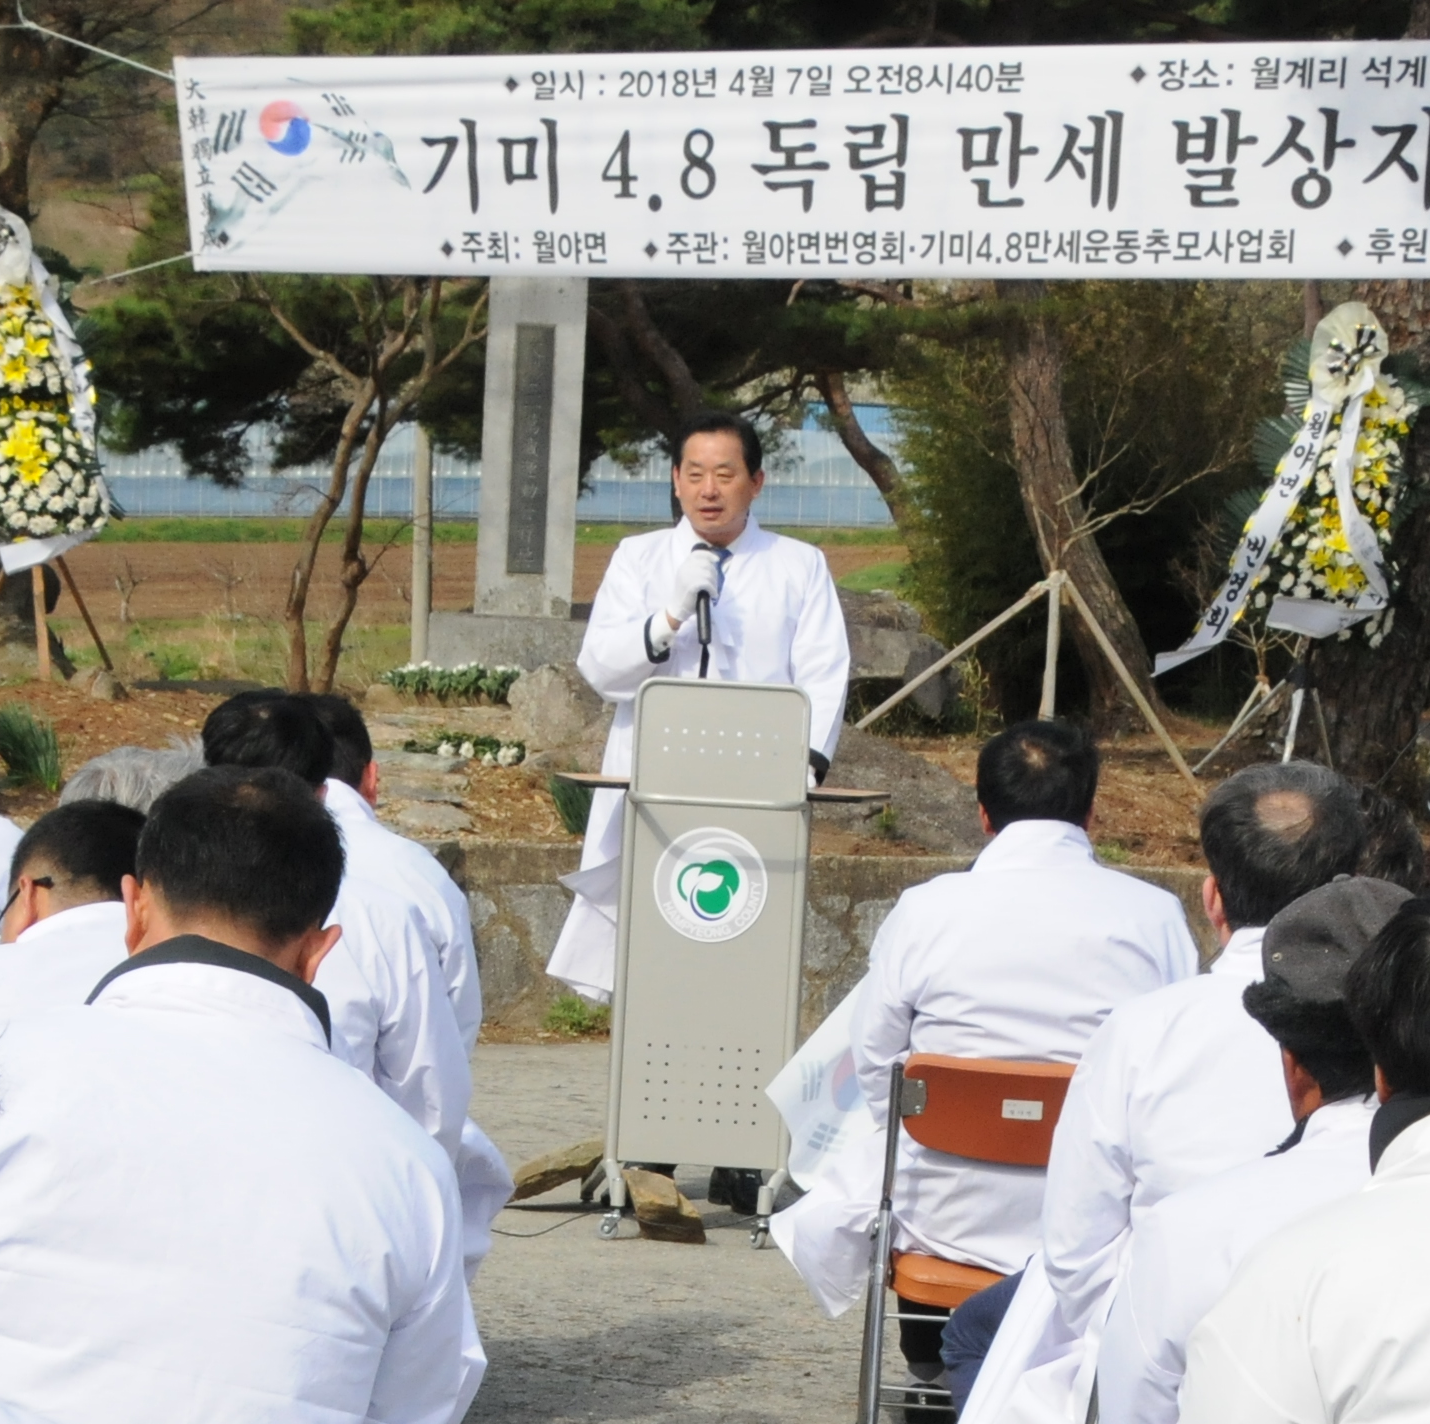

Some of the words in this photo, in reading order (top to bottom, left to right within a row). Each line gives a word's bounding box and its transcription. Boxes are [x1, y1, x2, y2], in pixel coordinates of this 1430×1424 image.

[530, 71, 585, 100] 일시
[618, 69, 717, 98] 2018년
[728, 67, 775, 98] 4월
[787, 67, 833, 97] 7일
[844, 63, 1024, 96] 오전8시40분
[1250, 57, 1349, 90] 월계리
[1361, 55, 1428, 90] 석계
[421, 117, 560, 214] 기미
[601, 129, 718, 212] 4.8
[750, 114, 910, 212] 독립
[956, 110, 1125, 211] 만세
[531, 230, 607, 264] 월야면
[733, 881, 762, 928] COUNTY
